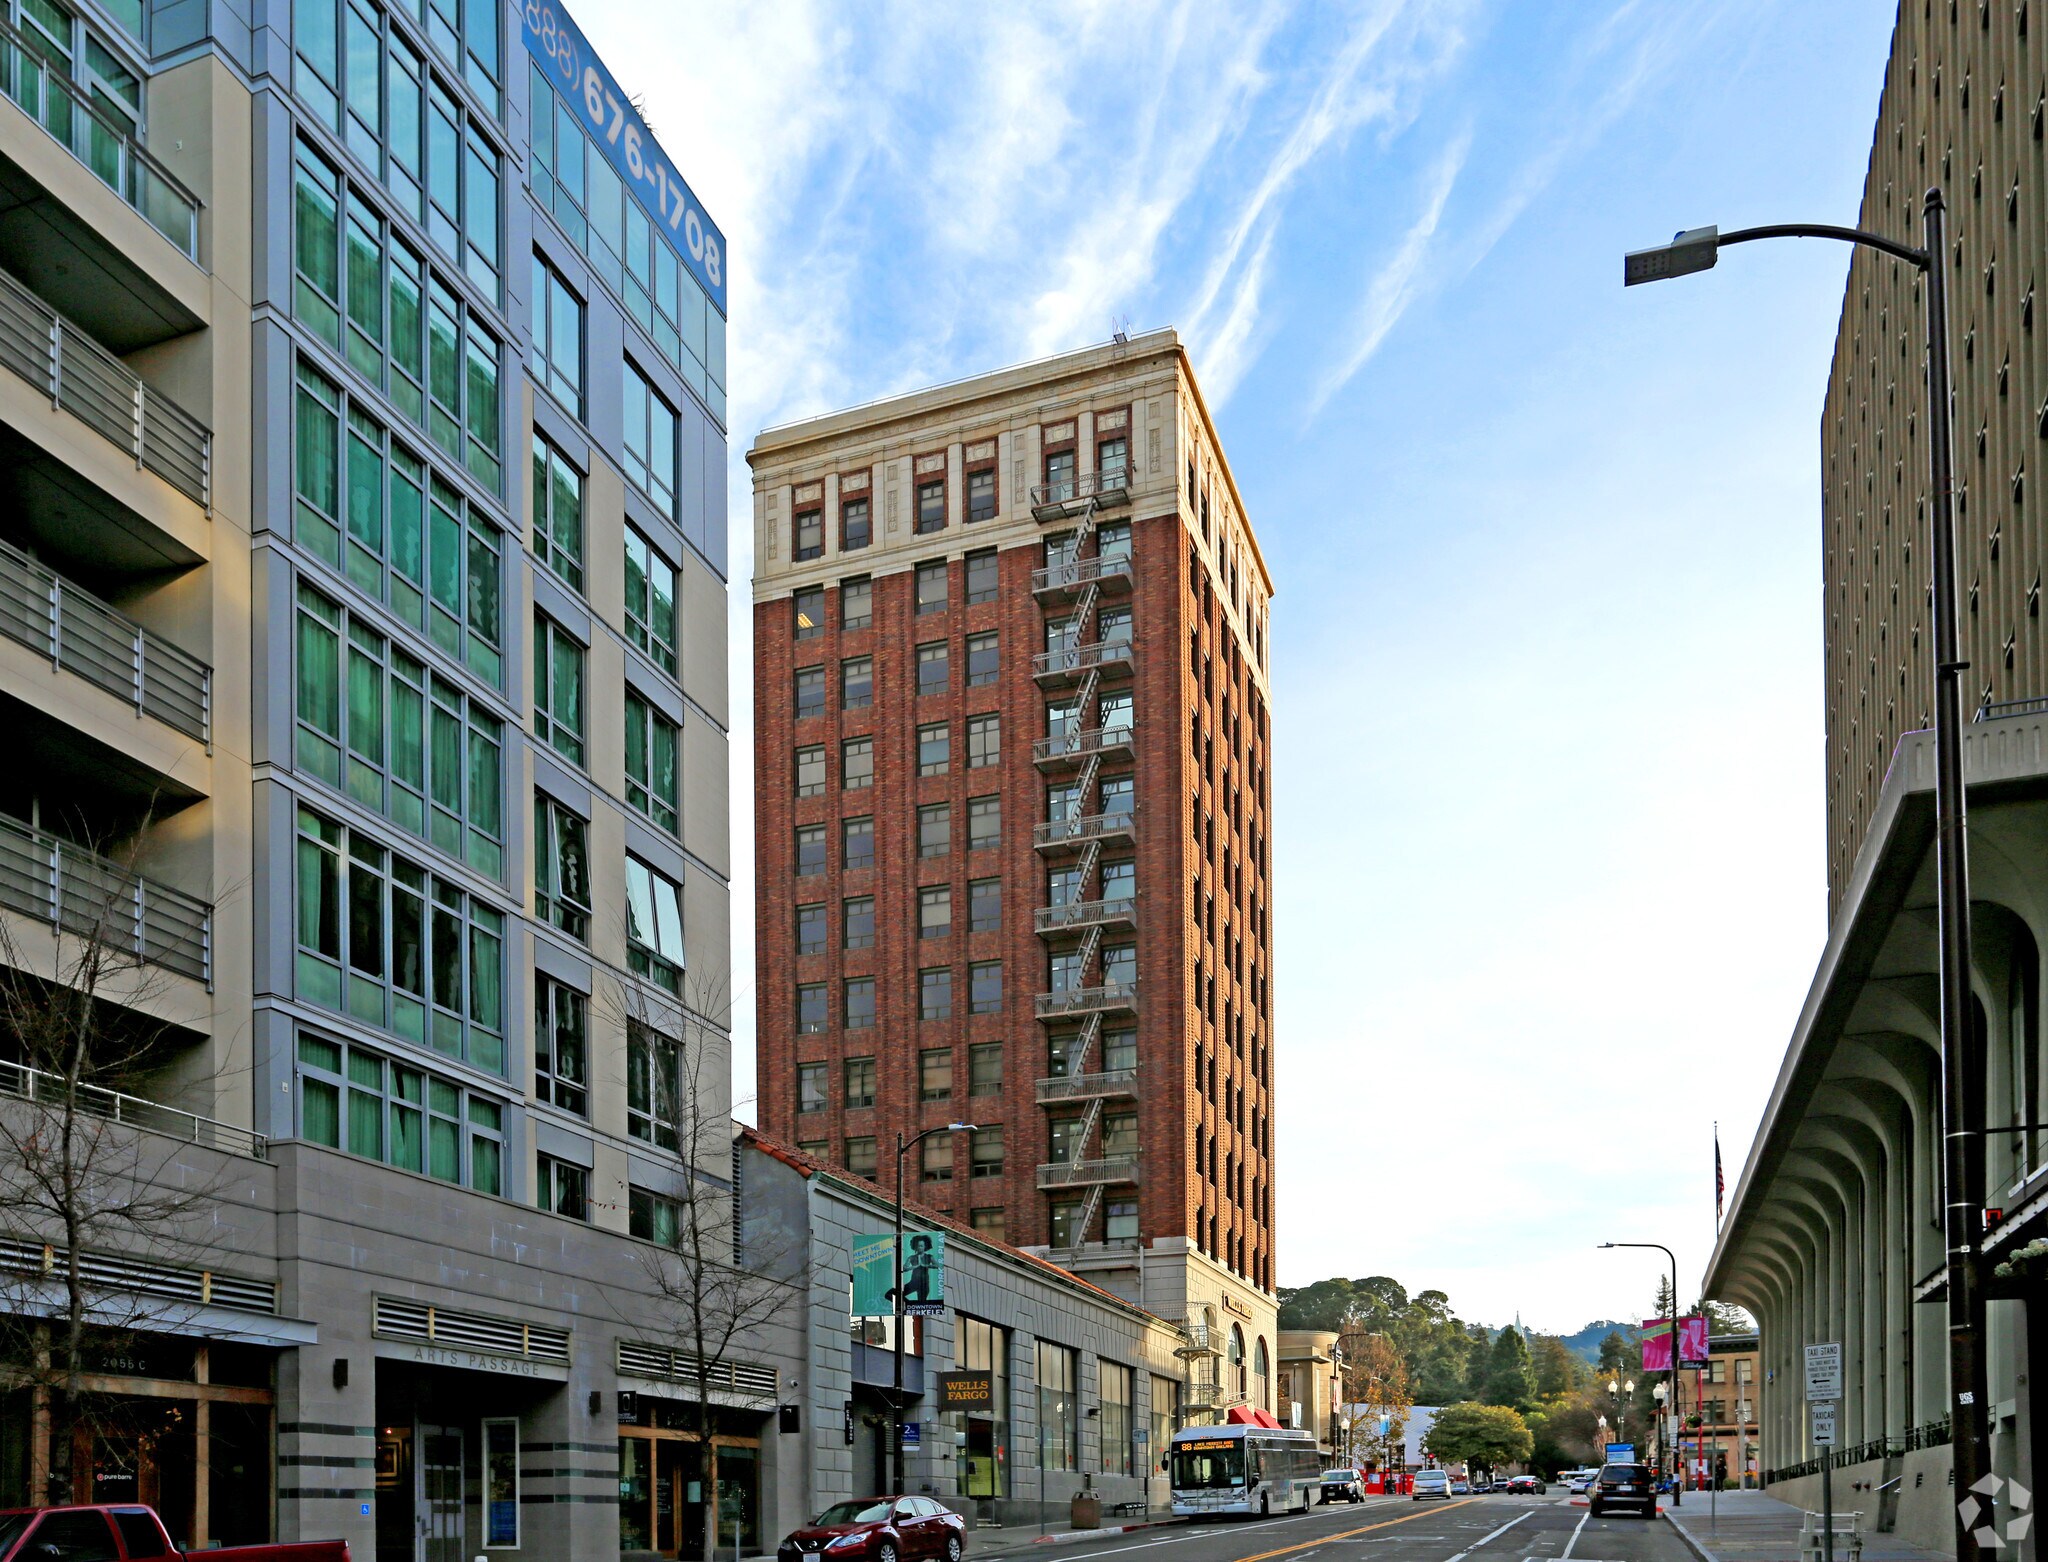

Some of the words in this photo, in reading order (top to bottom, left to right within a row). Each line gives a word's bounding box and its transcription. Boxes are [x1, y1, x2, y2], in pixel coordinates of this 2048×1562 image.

[583, 66, 722, 288] 676-1708
[937, 1231, 945, 1255] PLAY
[937, 1267, 945, 1297] WORK
[1807, 1348, 1819, 1356] TAXI
[1820, 1346, 1838, 1356] STAND
[101, 1357, 135, 1369] 2055
[138, 1359, 146, 1371] C
[414, 1347, 458, 1365] ARTS
[469, 1354, 539, 1376] PASSAGE
[946, 1380, 989, 1391] WELLS
[947, 1390, 989, 1401] FARGO
[1812, 1411, 1834, 1420] TAXICAB
[904, 1425, 911, 1434] 2
[1816, 1423, 1831, 1432] ONLY
[1181, 1443, 1192, 1451] 88
